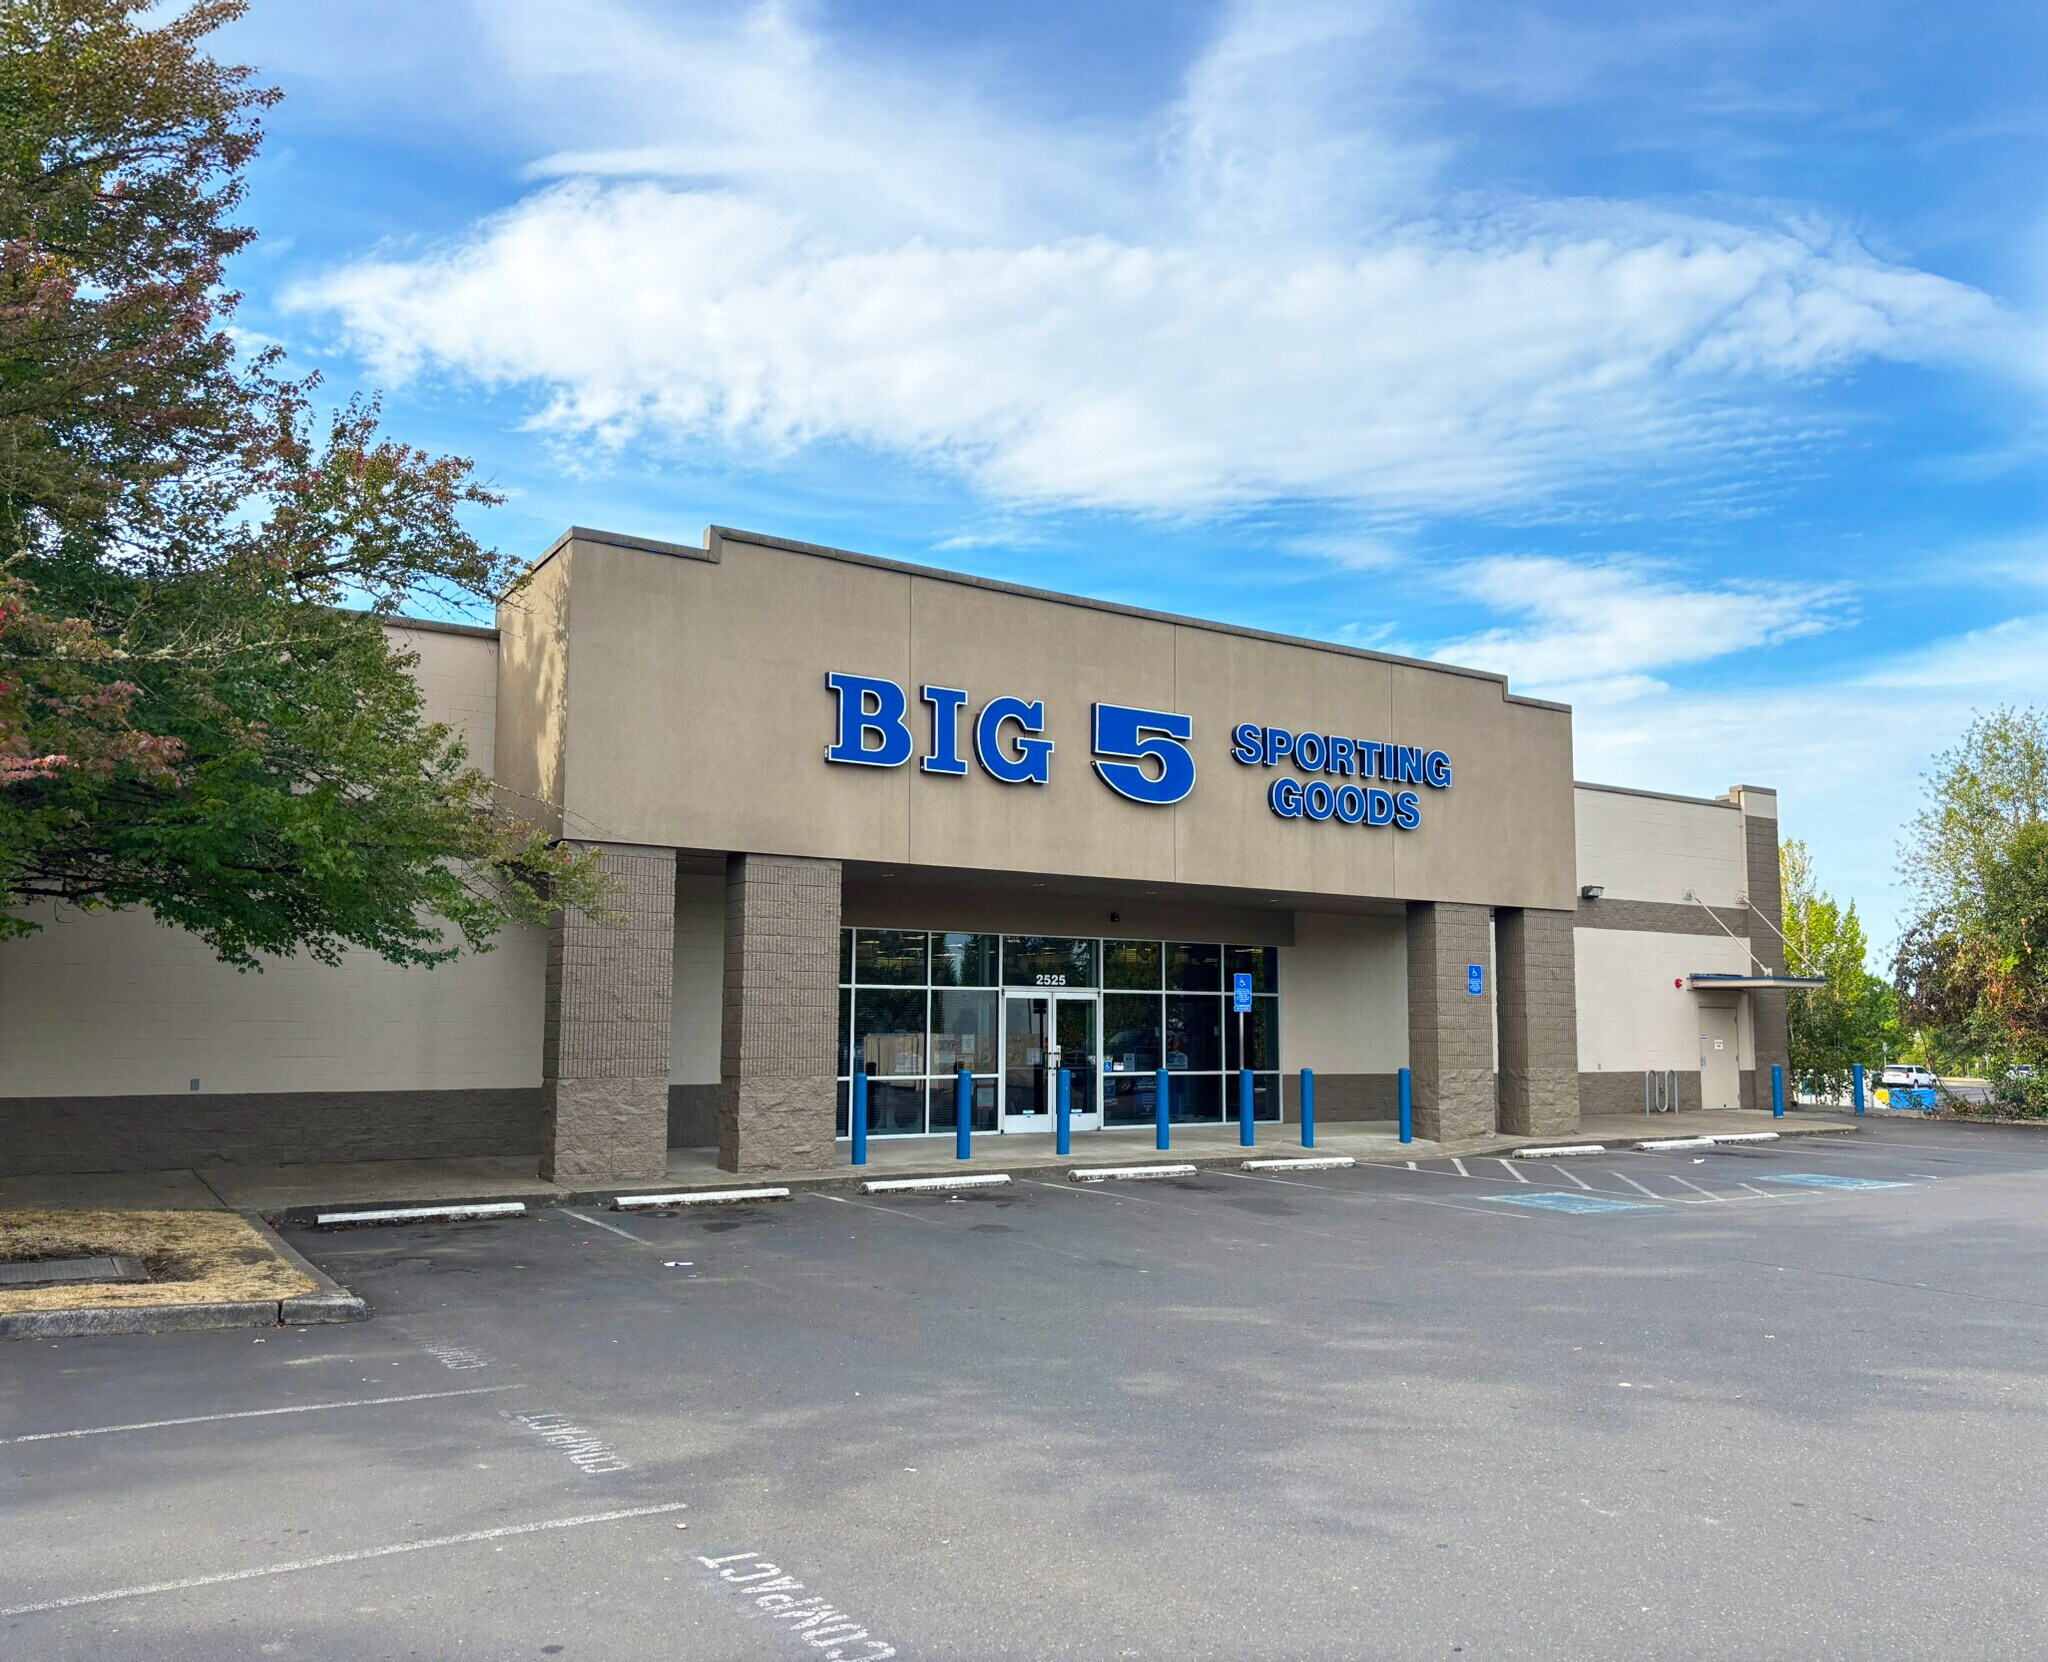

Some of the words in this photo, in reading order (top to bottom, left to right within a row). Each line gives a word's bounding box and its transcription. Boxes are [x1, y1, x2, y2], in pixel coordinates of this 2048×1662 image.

[824, 671, 1055, 786] BIG
[1091, 702, 1196, 805] 5
[1231, 722, 1453, 788] SPORTING
[1268, 777, 1422, 831] GOODS
[1035, 974, 1067, 986] 2525
[697, 1552, 897, 1662] COMPACT
